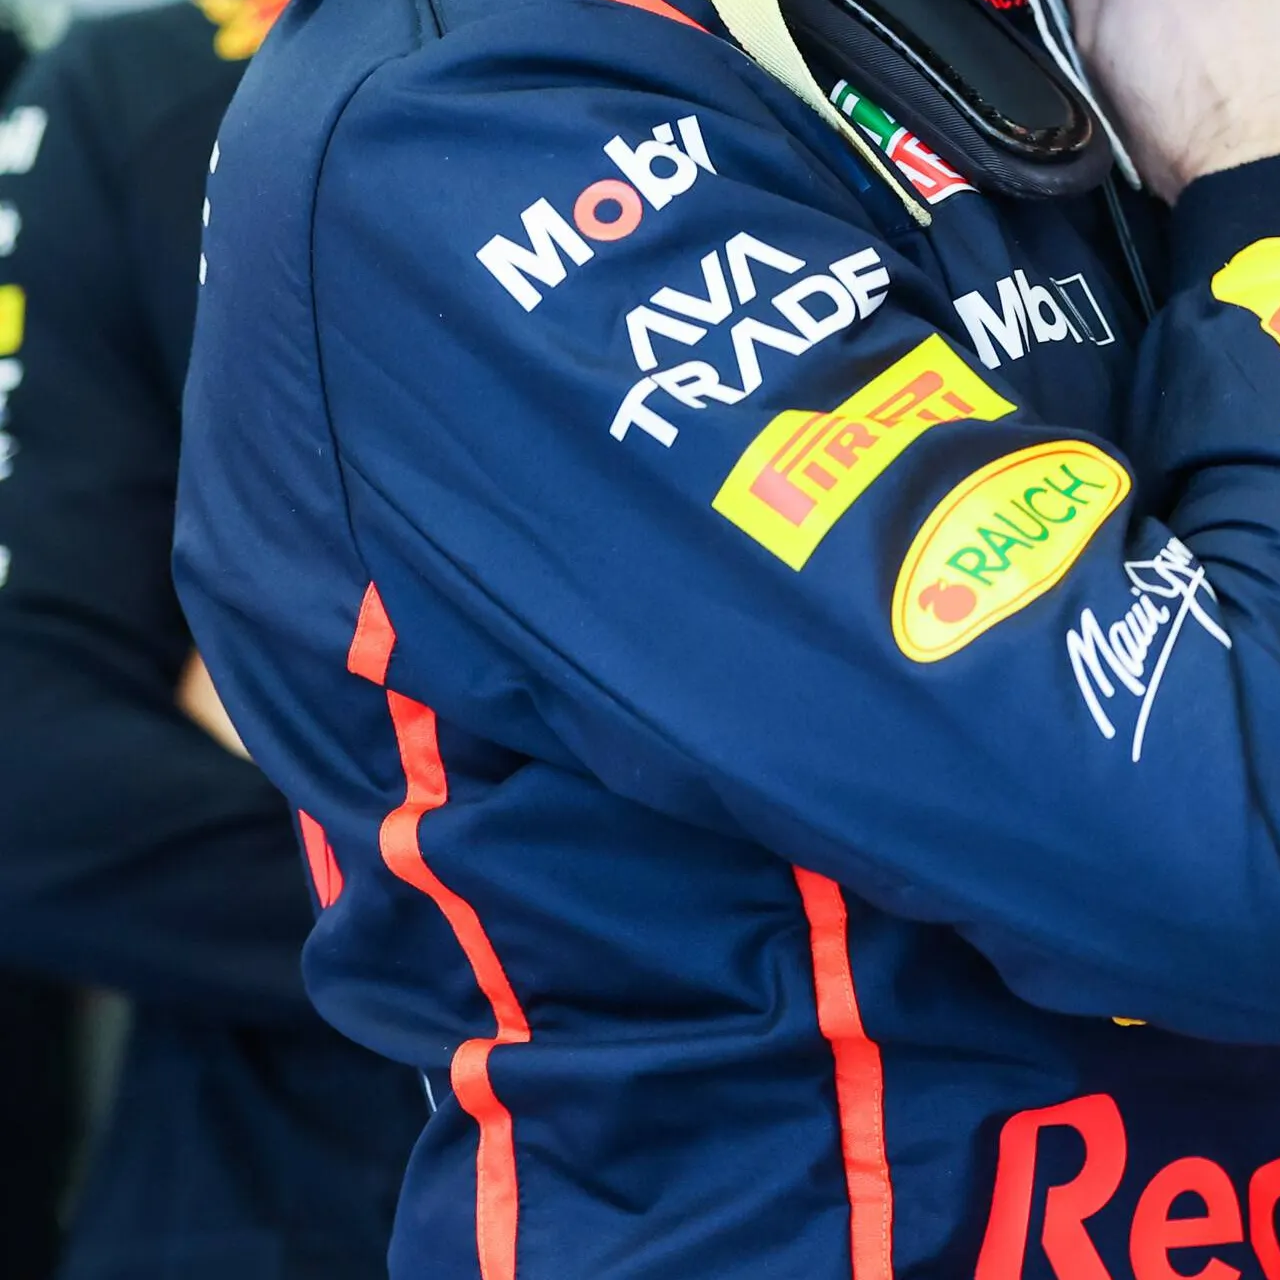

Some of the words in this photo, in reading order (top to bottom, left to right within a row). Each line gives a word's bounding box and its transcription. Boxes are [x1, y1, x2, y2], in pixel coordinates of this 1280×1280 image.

[609, 247, 891, 448] TRADE
[625, 232, 806, 371] AVA
[946, 464, 1107, 586] RAUCH
